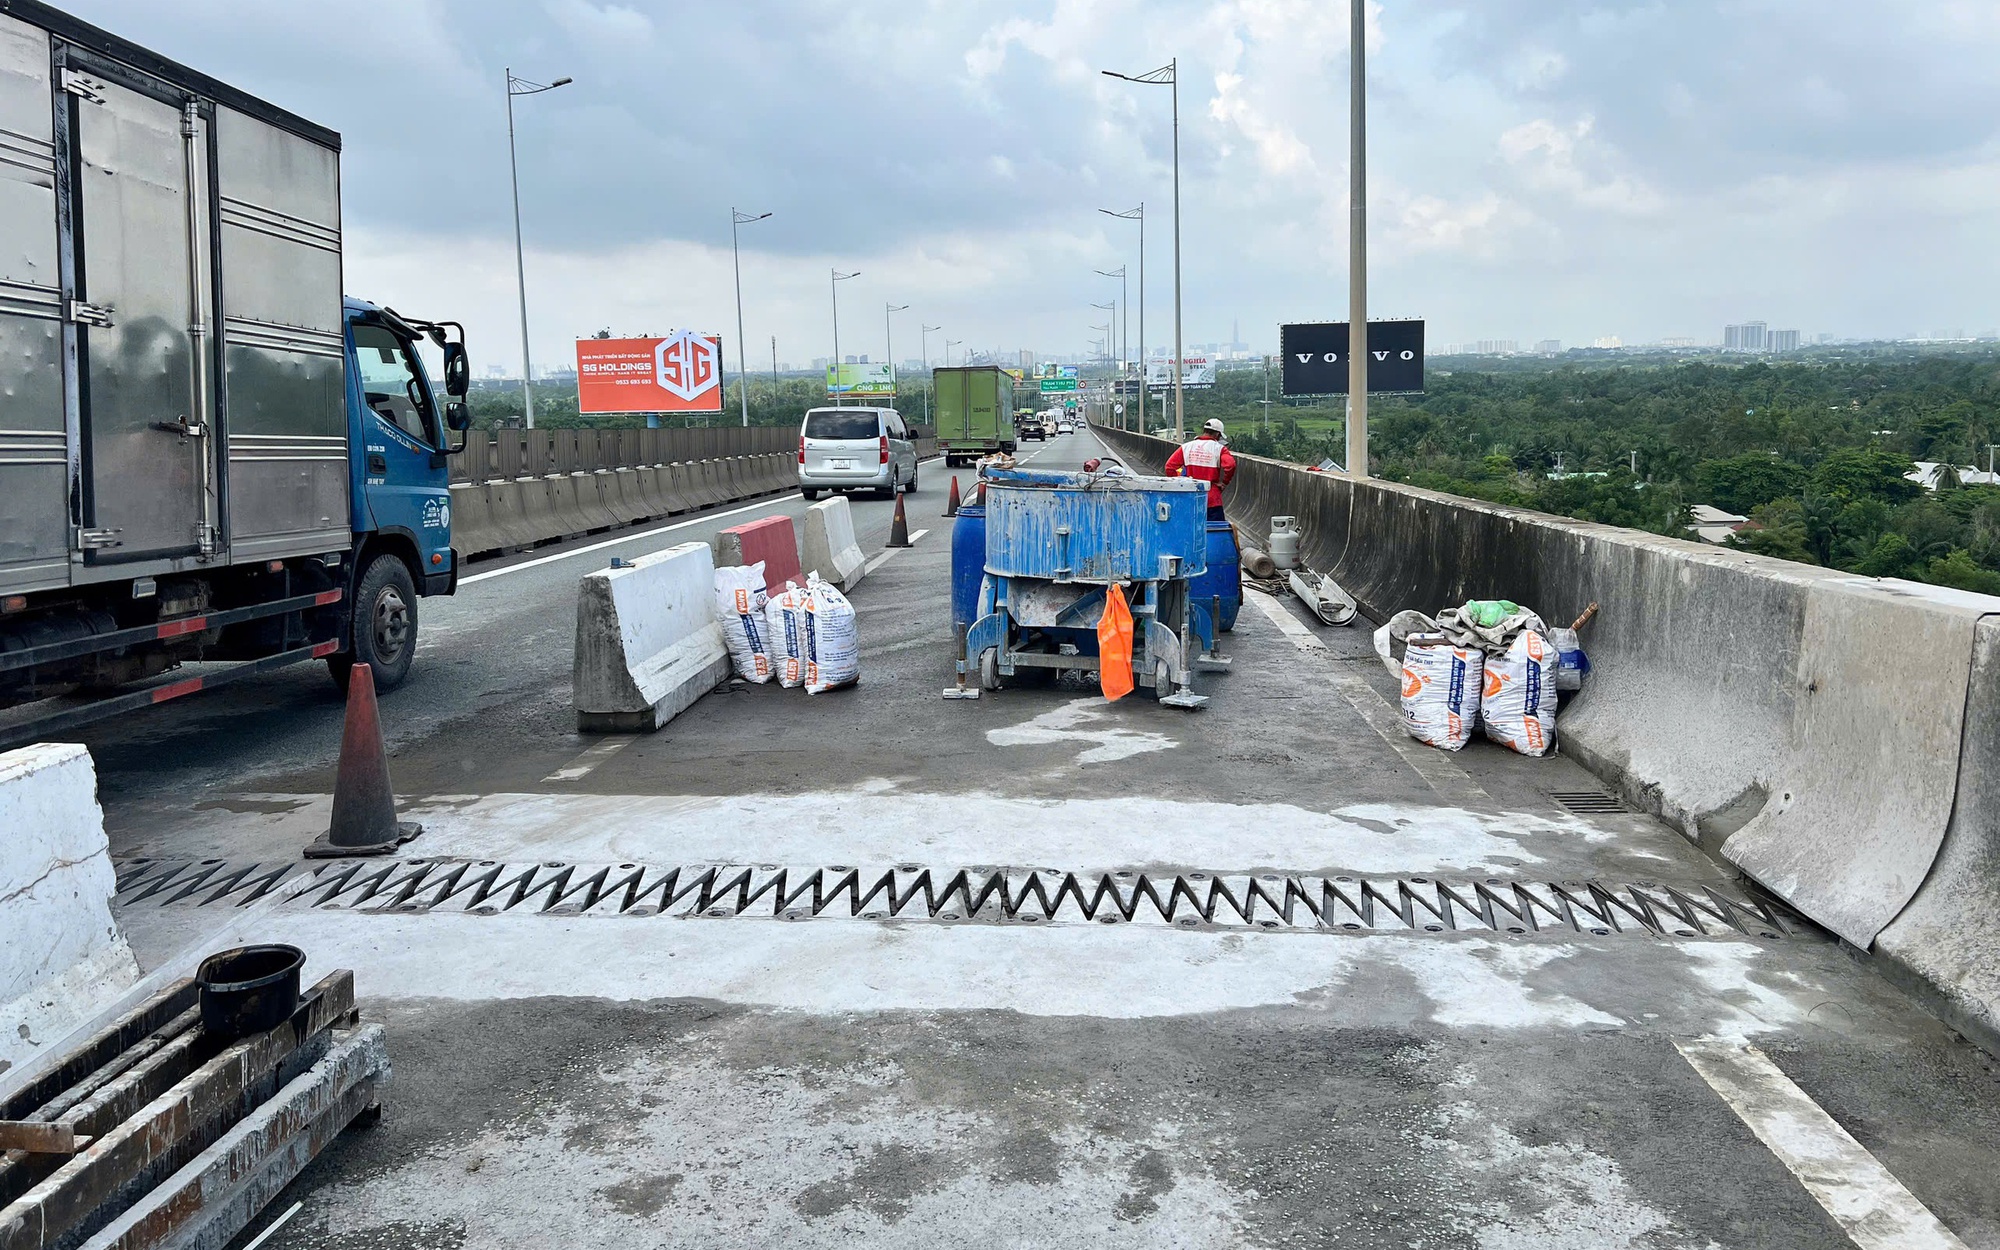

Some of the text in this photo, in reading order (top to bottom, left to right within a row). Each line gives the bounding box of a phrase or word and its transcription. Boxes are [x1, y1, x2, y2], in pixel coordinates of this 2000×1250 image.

[1295, 350, 1414, 364] VOVO
[582, 362, 652, 372] SG HOLDINGS
[376, 421, 412, 450] THACO OLLIN
